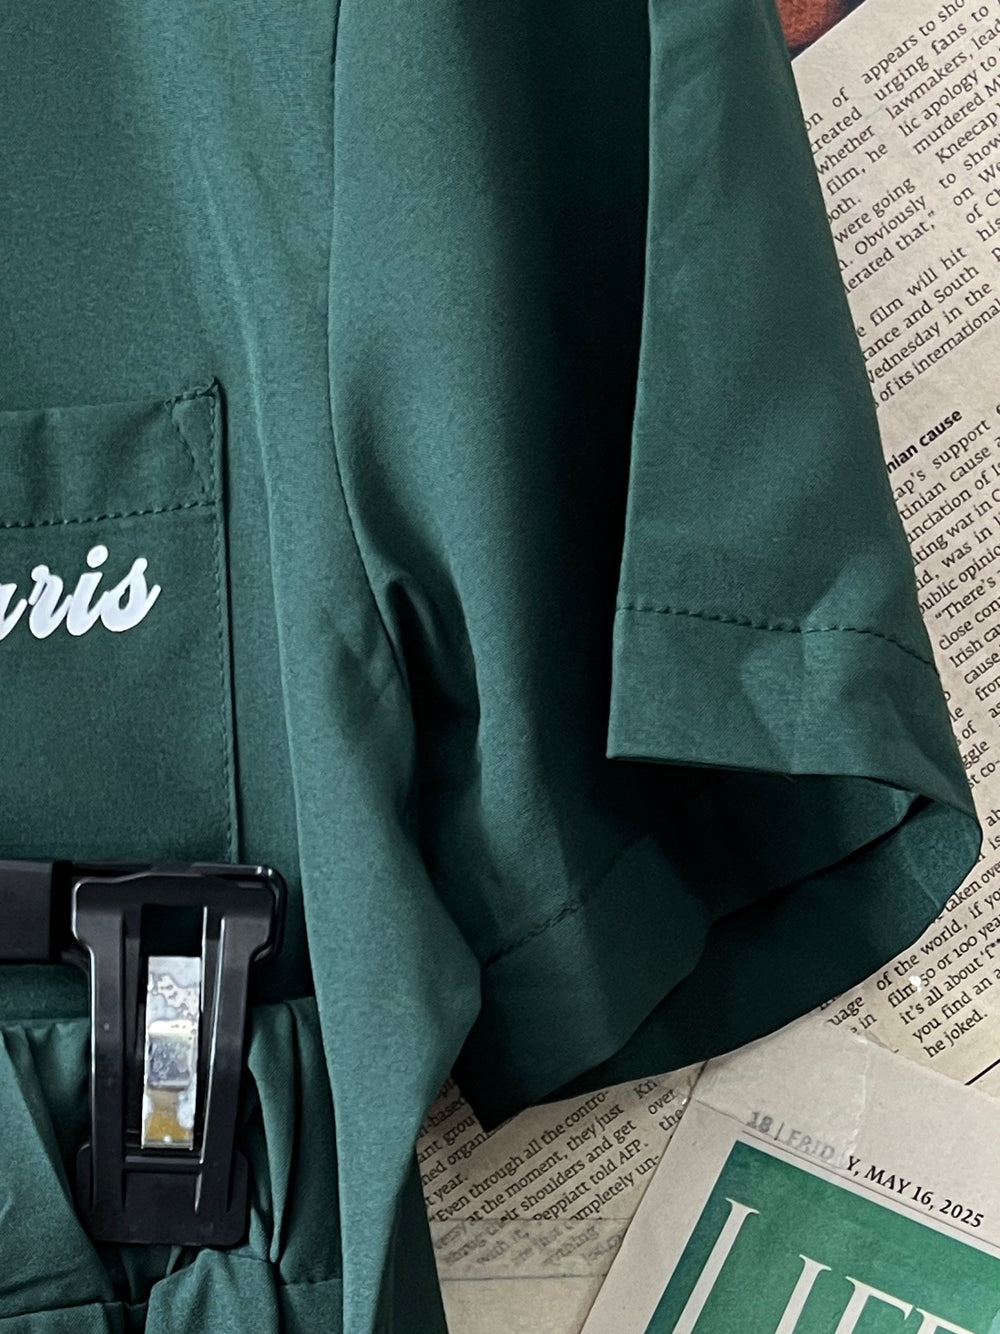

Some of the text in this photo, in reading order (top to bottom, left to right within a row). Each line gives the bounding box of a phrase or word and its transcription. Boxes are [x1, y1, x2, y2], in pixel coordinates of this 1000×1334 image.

[861, 20, 936, 84] appears to
[874, 5, 989, 101] urging fans to
[832, 86, 850, 108] of
[885, 51, 974, 120] lawmakers,
[898, 56, 997, 137] lic apology to
[912, 91, 986, 155] murdered
[826, 144, 888, 196] film, he
[854, 195, 926, 255] Obviously
[870, 247, 967, 327] film will hit
[903, 266, 980, 329] and South
[942, 283, 993, 324] in the
[919, 410, 963, 447] cause
[932, 419, 991, 469] support
[945, 500, 993, 537] war in
[939, 623, 973, 652] close
[949, 640, 984, 668] Irish
[876, 900, 984, 991] of the world, if
[899, 957, 984, 1025] it's all about
[912, 977, 993, 1044] you find an
[923, 1008, 988, 1058] he joked.
[504, 1104, 625, 1198] moment, they just
[520, 1120, 637, 1212] shoulders and get
[589, 1139, 649, 1185] told AFP.
[865, 1165, 912, 1195] MAY
[912, 1186, 935, 1212] 16,
[939, 1199, 985, 1228] 2025
